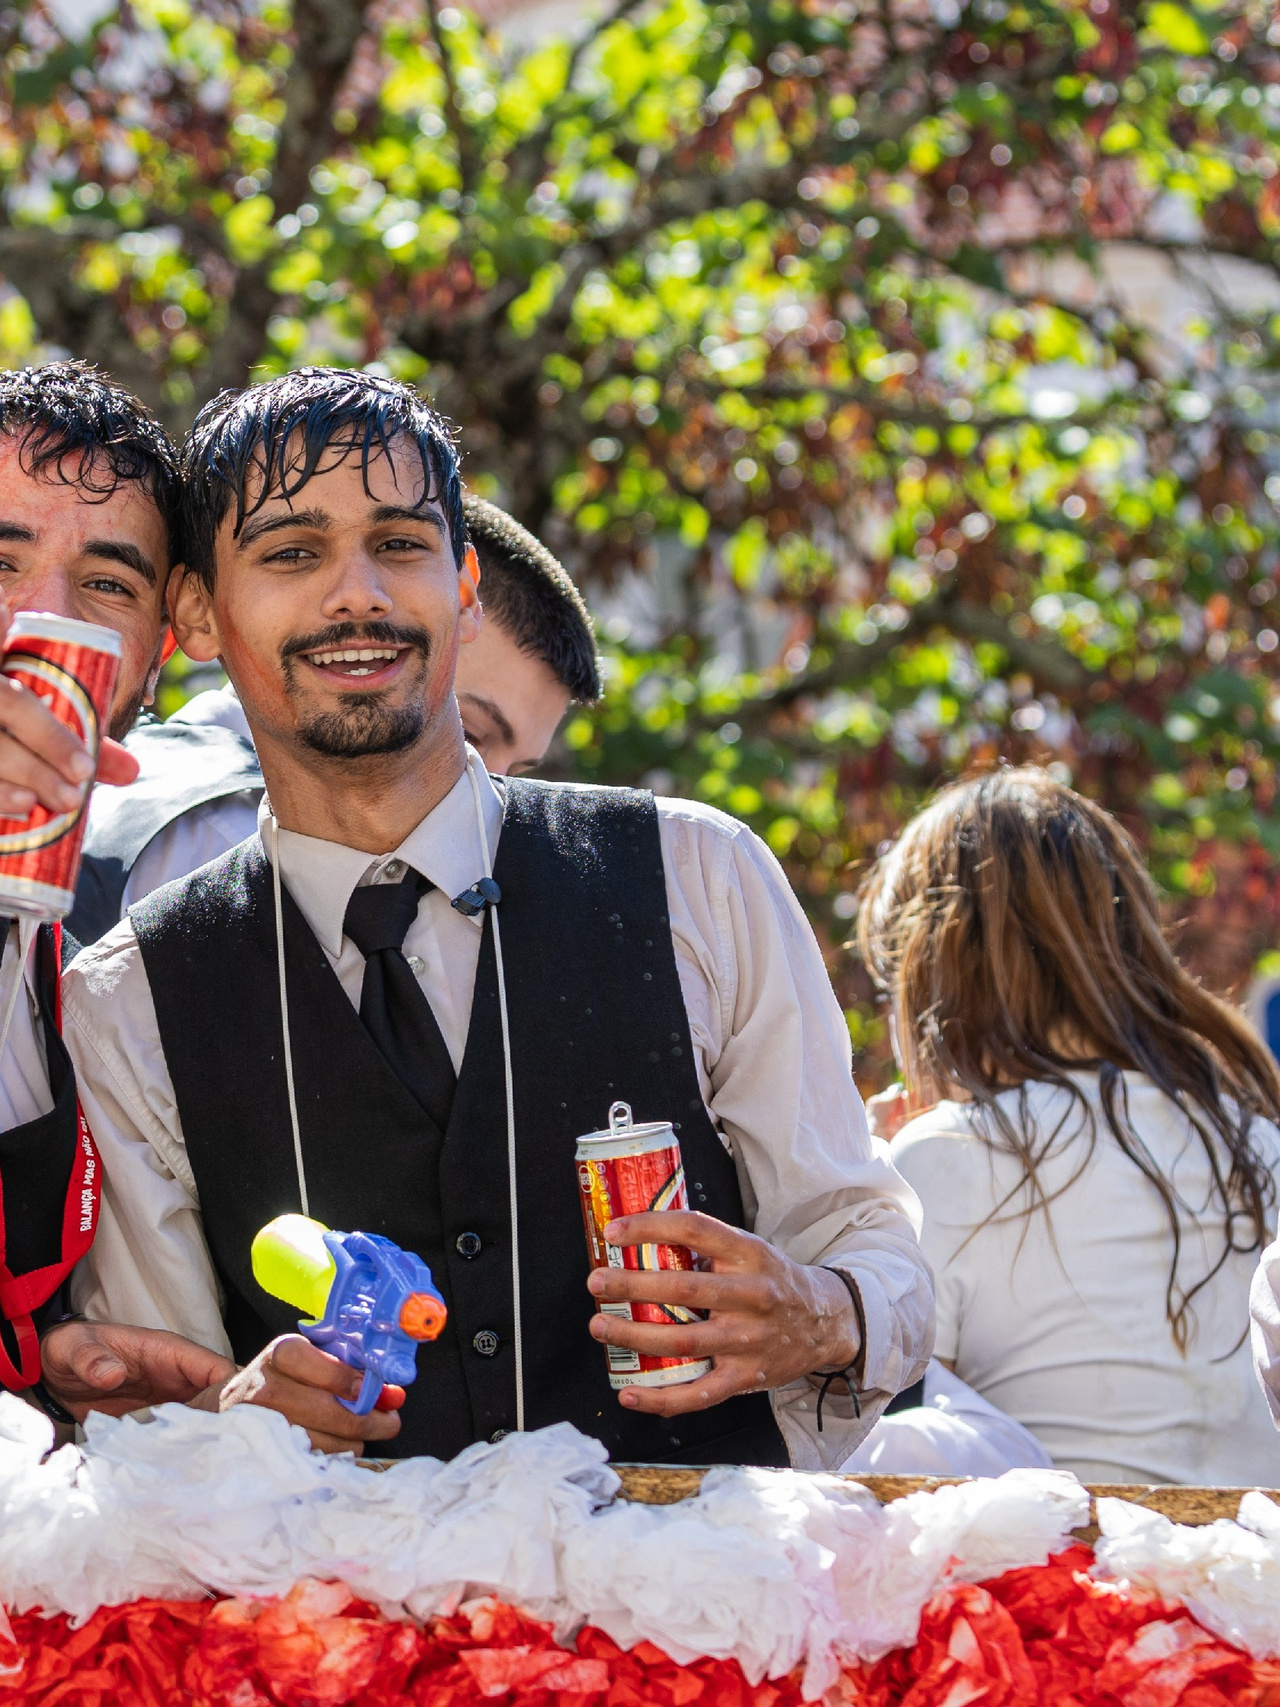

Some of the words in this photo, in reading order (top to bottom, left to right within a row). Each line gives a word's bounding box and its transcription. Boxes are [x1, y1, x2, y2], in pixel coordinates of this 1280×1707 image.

[82, 1135, 95, 1157] NÃO
[83, 1159, 96, 1185] MAS
[80, 1188, 96, 1232] BALANÇA
